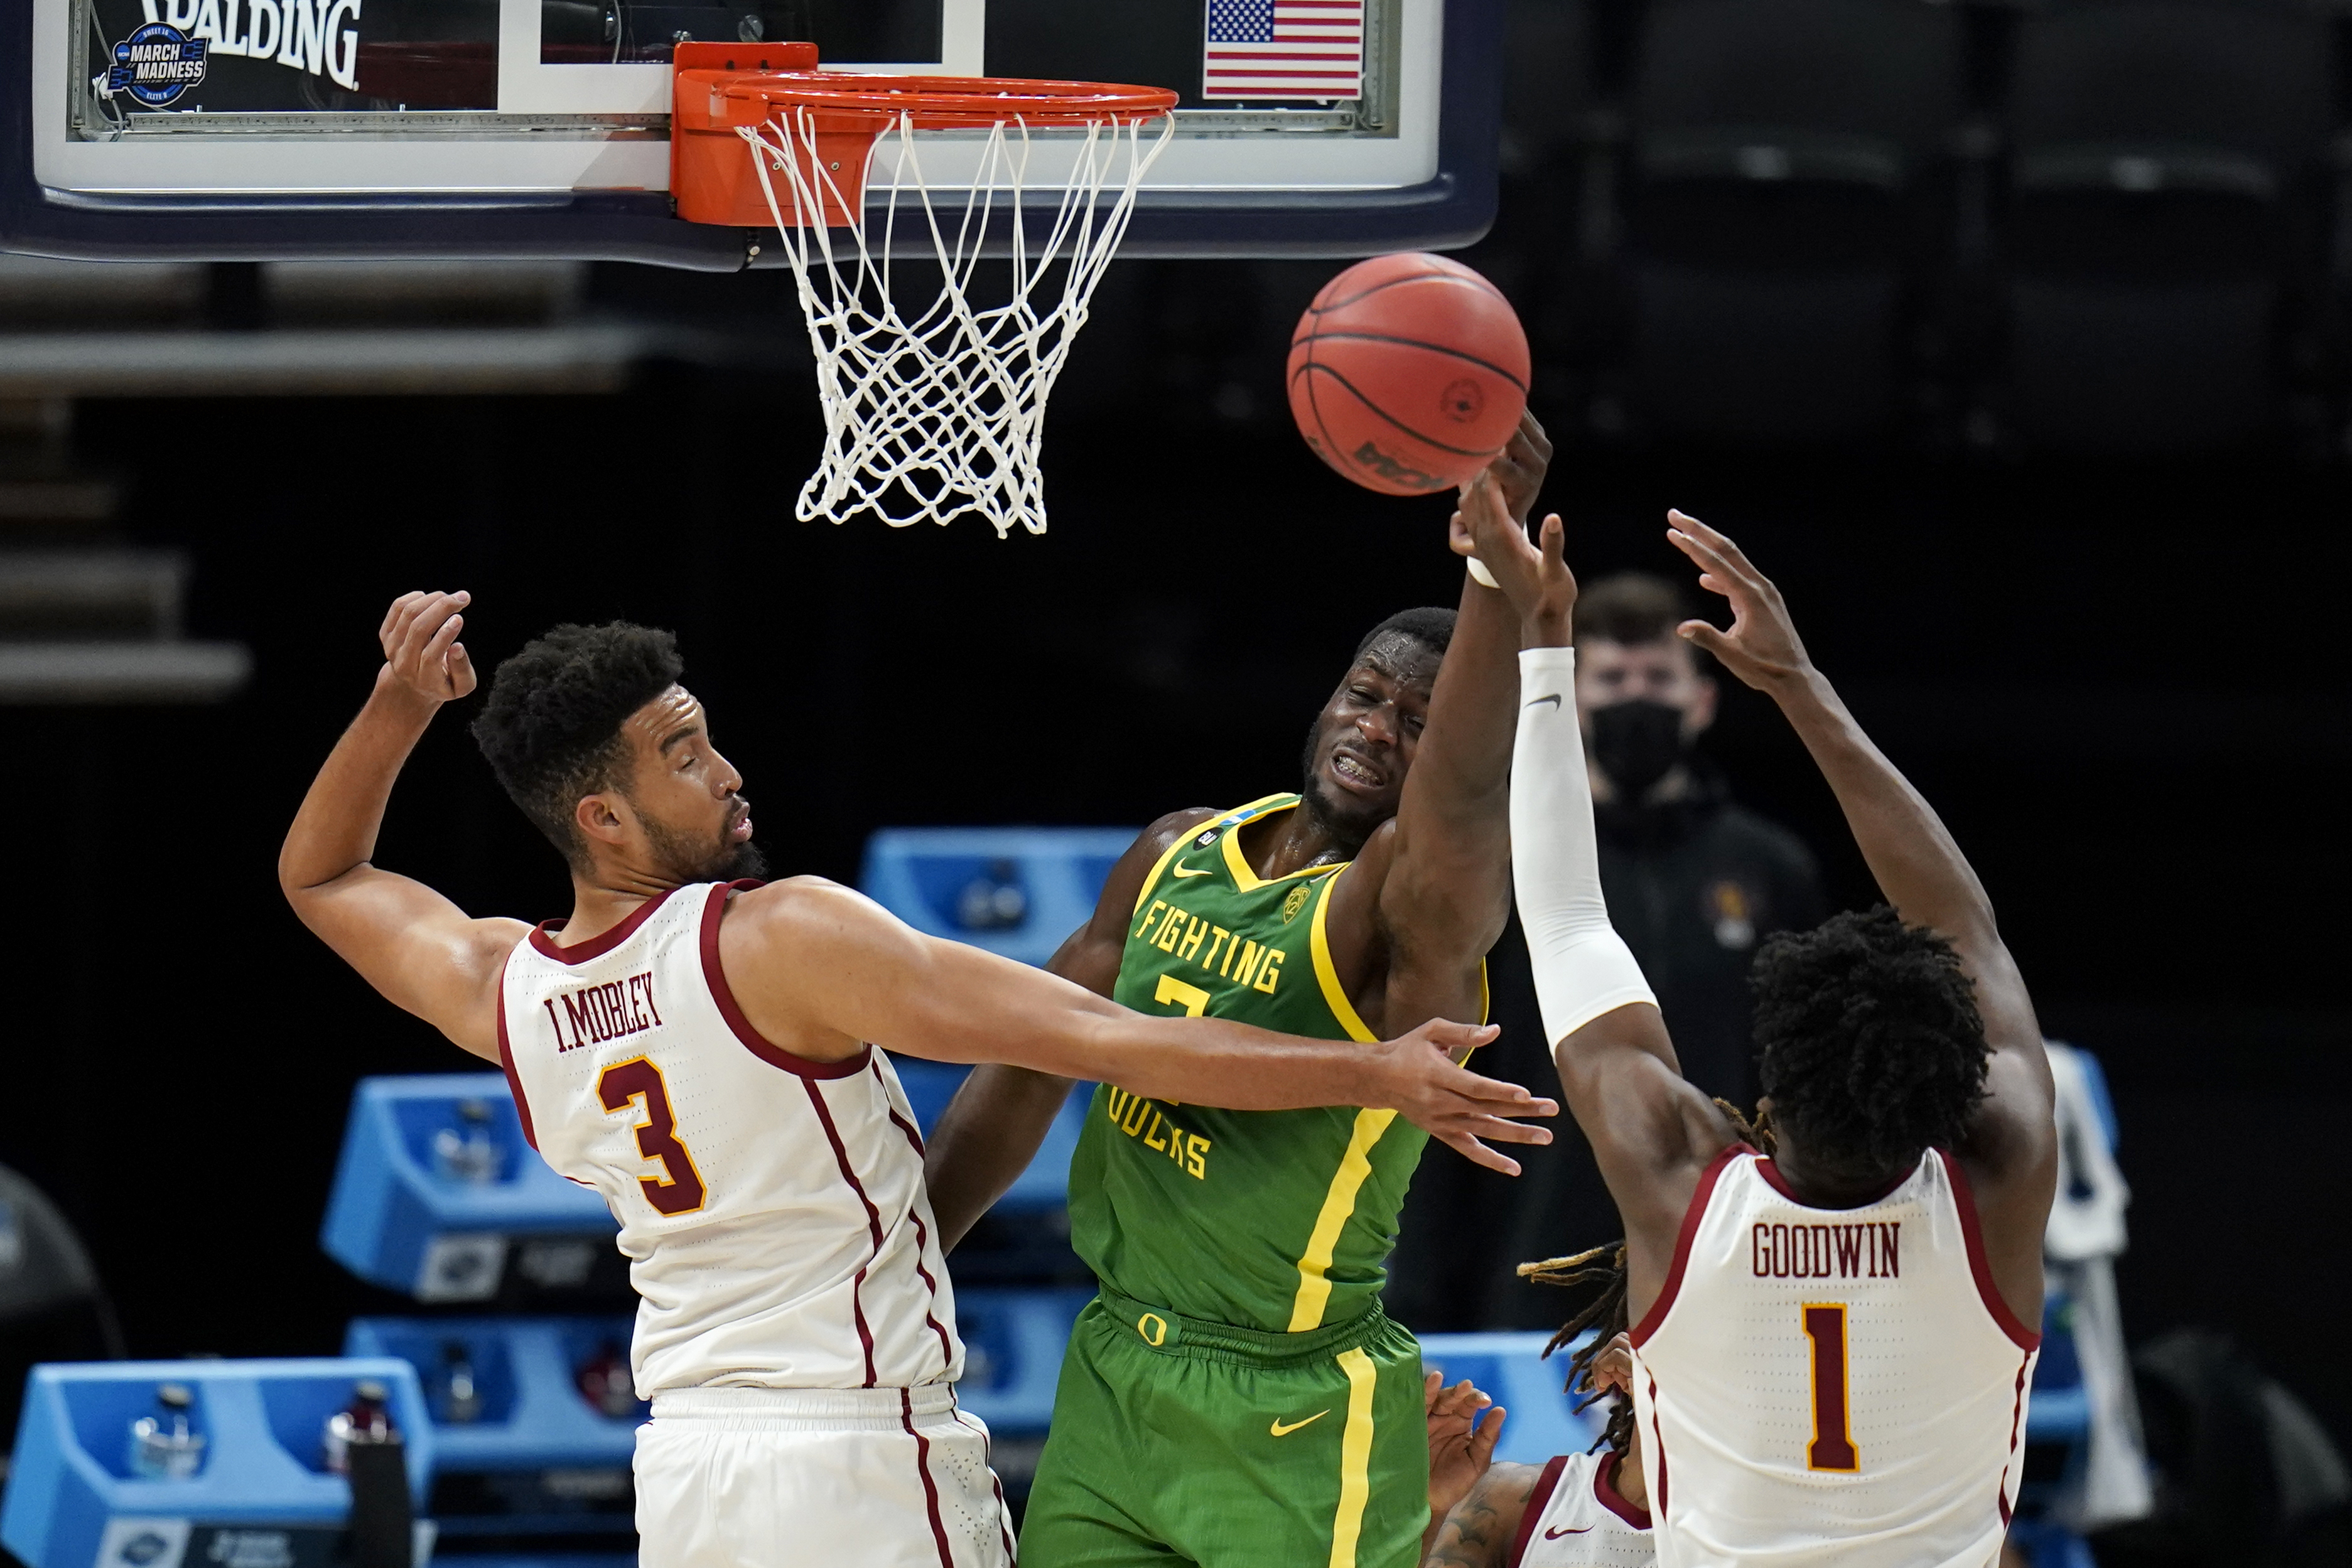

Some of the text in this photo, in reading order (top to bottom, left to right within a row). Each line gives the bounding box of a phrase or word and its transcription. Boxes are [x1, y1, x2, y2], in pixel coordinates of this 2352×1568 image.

[130, 44, 181, 62] MARCH
[136, 61, 203, 79] MADNESS
[1134, 900, 1286, 994] FIGHTING
[544, 971, 662, 1053] I.MOBLEY
[596, 1055, 708, 1217] 3
[1752, 1222, 1901, 1278] GOODWIN
[1801, 1302, 1860, 1473] 1
